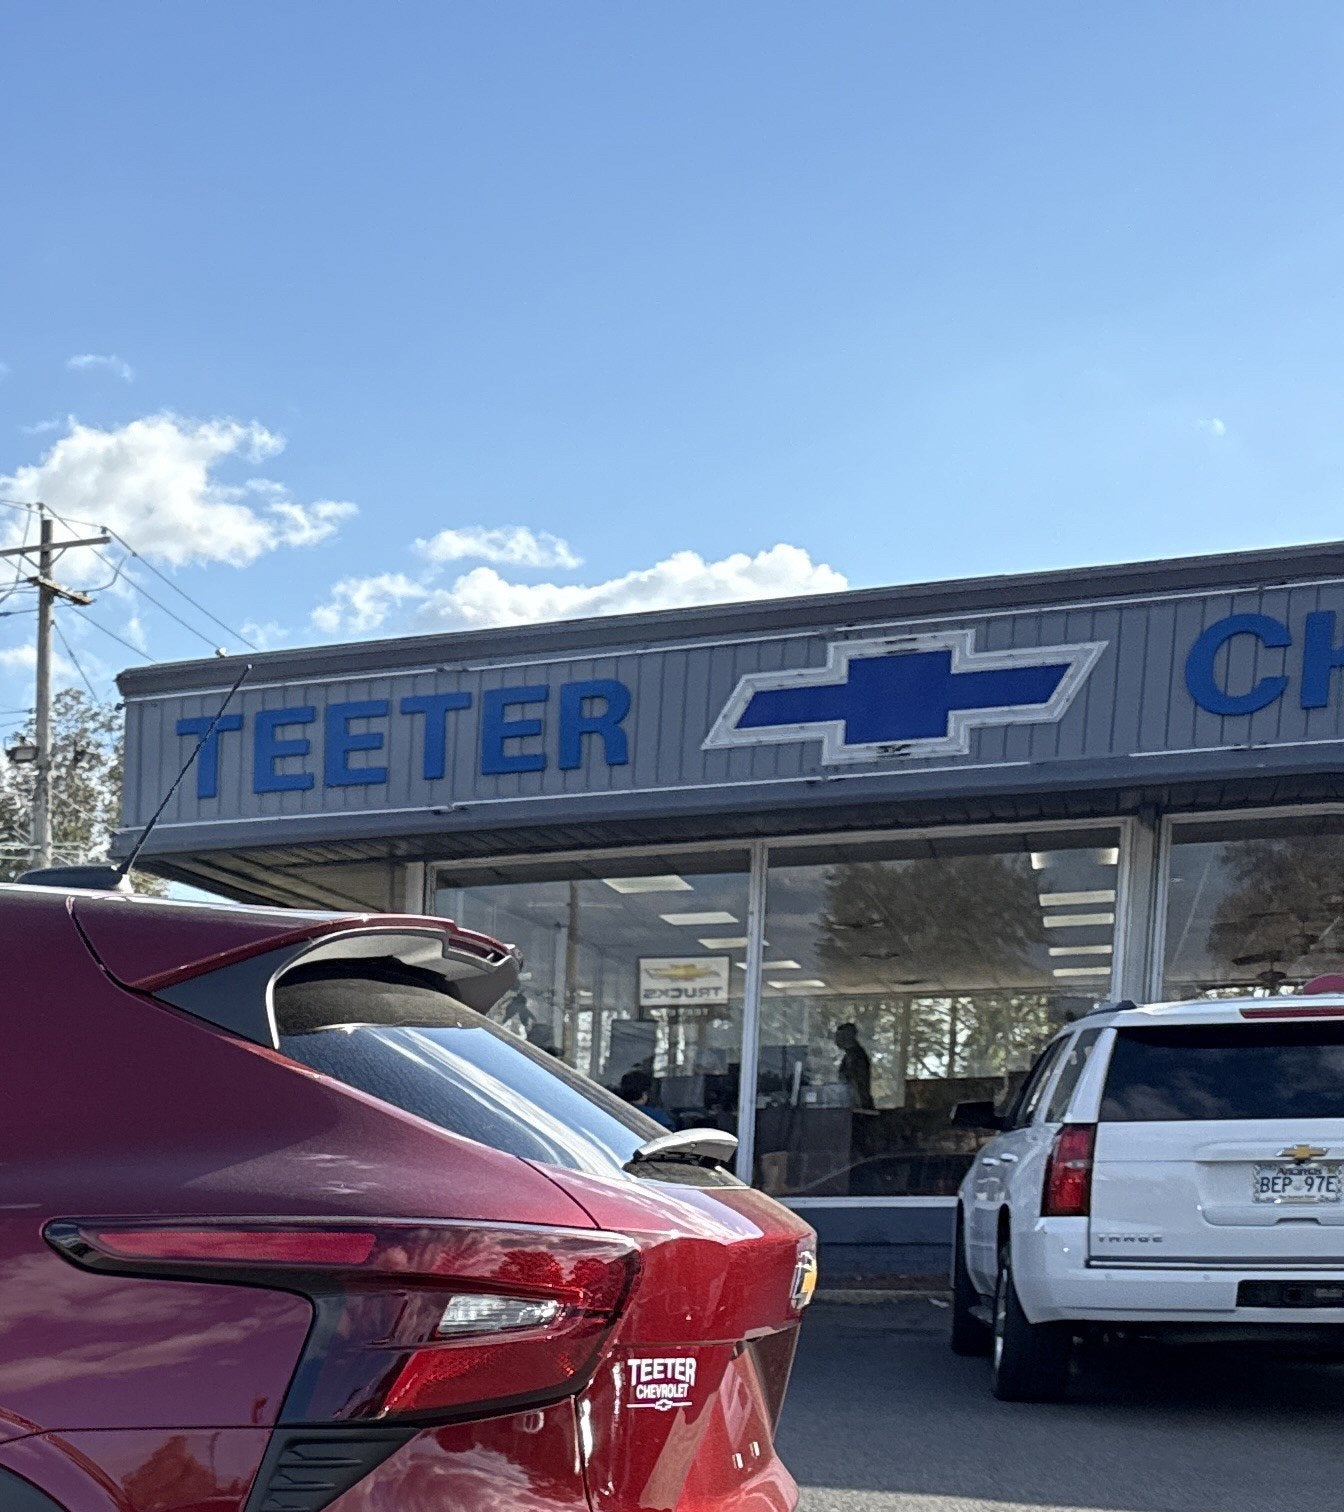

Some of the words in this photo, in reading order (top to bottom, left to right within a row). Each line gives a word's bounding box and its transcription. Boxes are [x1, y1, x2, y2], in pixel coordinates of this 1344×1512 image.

[176, 678, 632, 800] TEETER
[1259, 1176, 1293, 1193] BEP
[1304, 1175, 1337, 1192] 97E
[627, 1357, 697, 1387] TEETER
[636, 1383, 689, 1399] CHEVROLET
